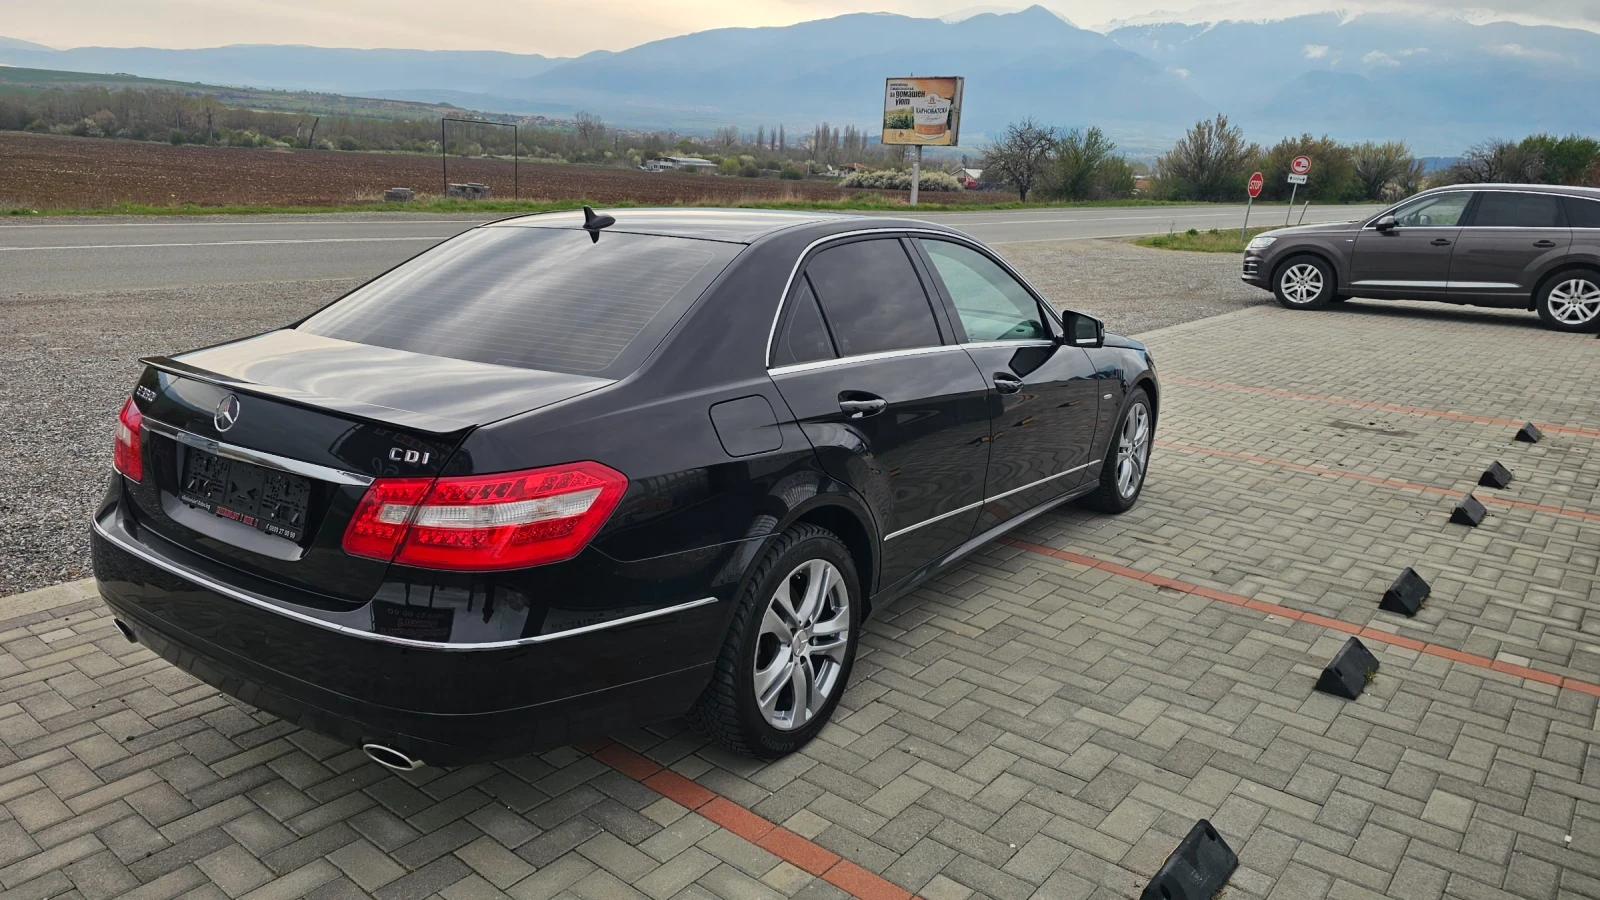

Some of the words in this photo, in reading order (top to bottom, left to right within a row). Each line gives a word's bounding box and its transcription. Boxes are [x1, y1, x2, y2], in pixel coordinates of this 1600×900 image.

[1250, 180, 1262, 190] STOP
[389, 447, 430, 464] CDI
[760, 735, 794, 751] KUMHO
